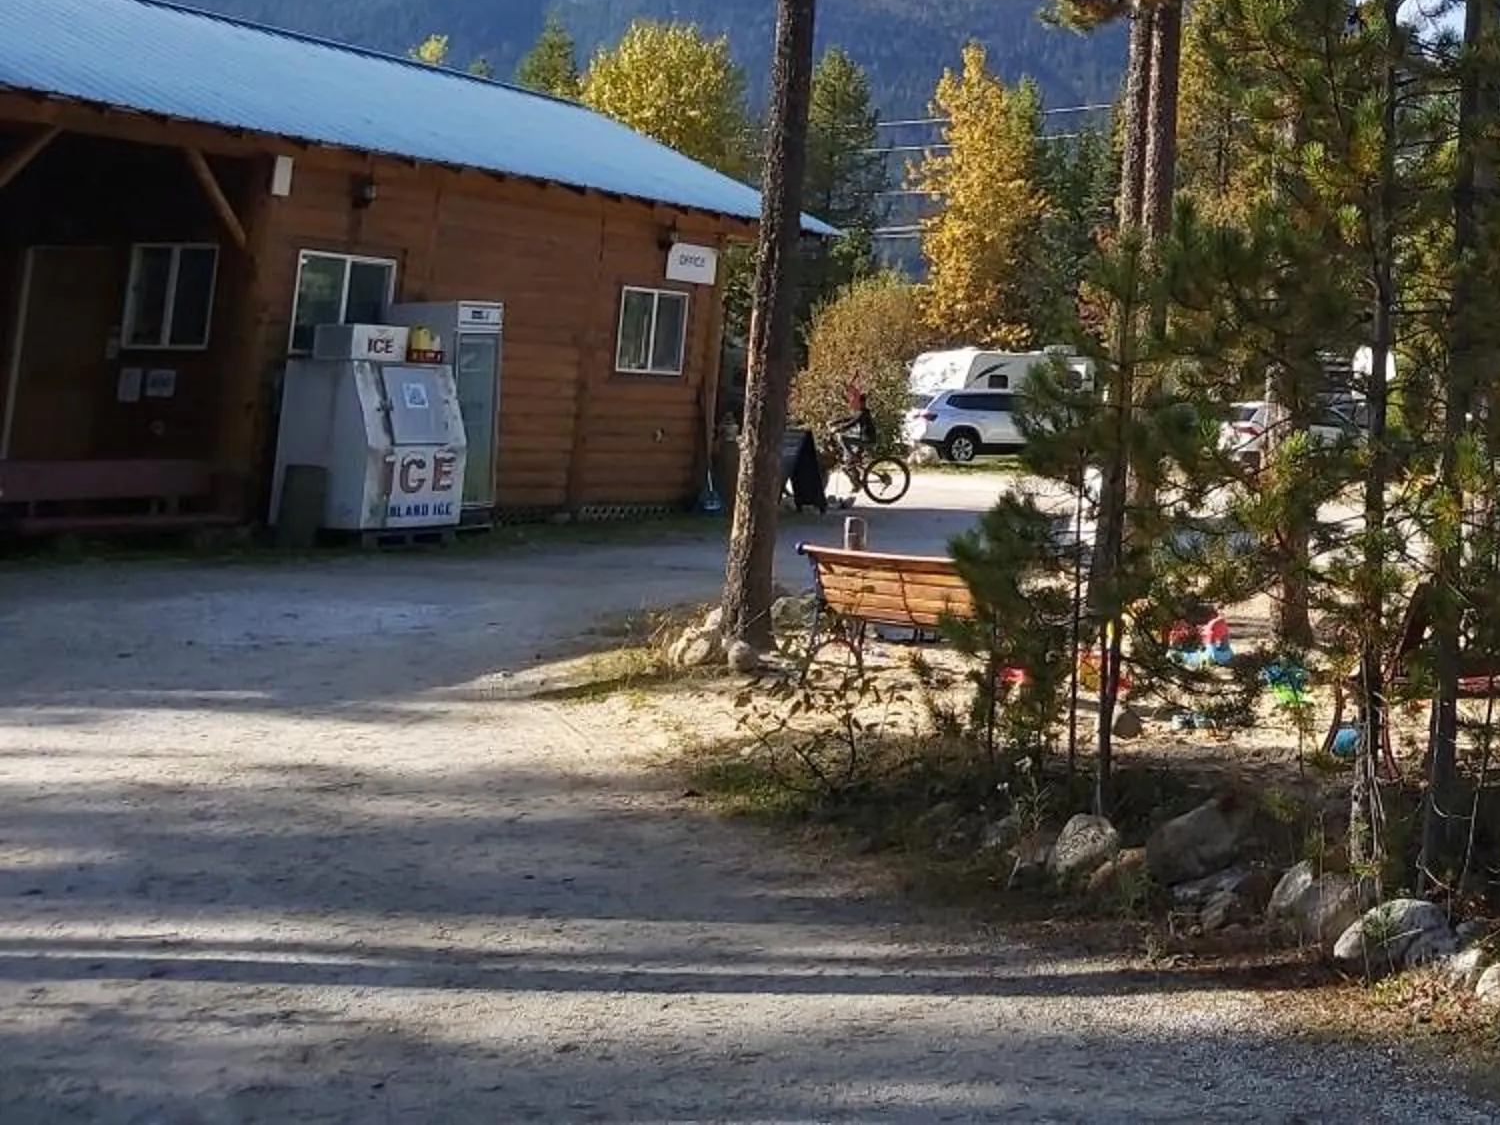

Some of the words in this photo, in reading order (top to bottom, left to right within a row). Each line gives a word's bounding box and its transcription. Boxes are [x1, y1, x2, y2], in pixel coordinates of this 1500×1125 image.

[367, 336, 394, 354] ICE
[383, 449, 457, 494] ICE
[432, 501, 453, 515] ICE
